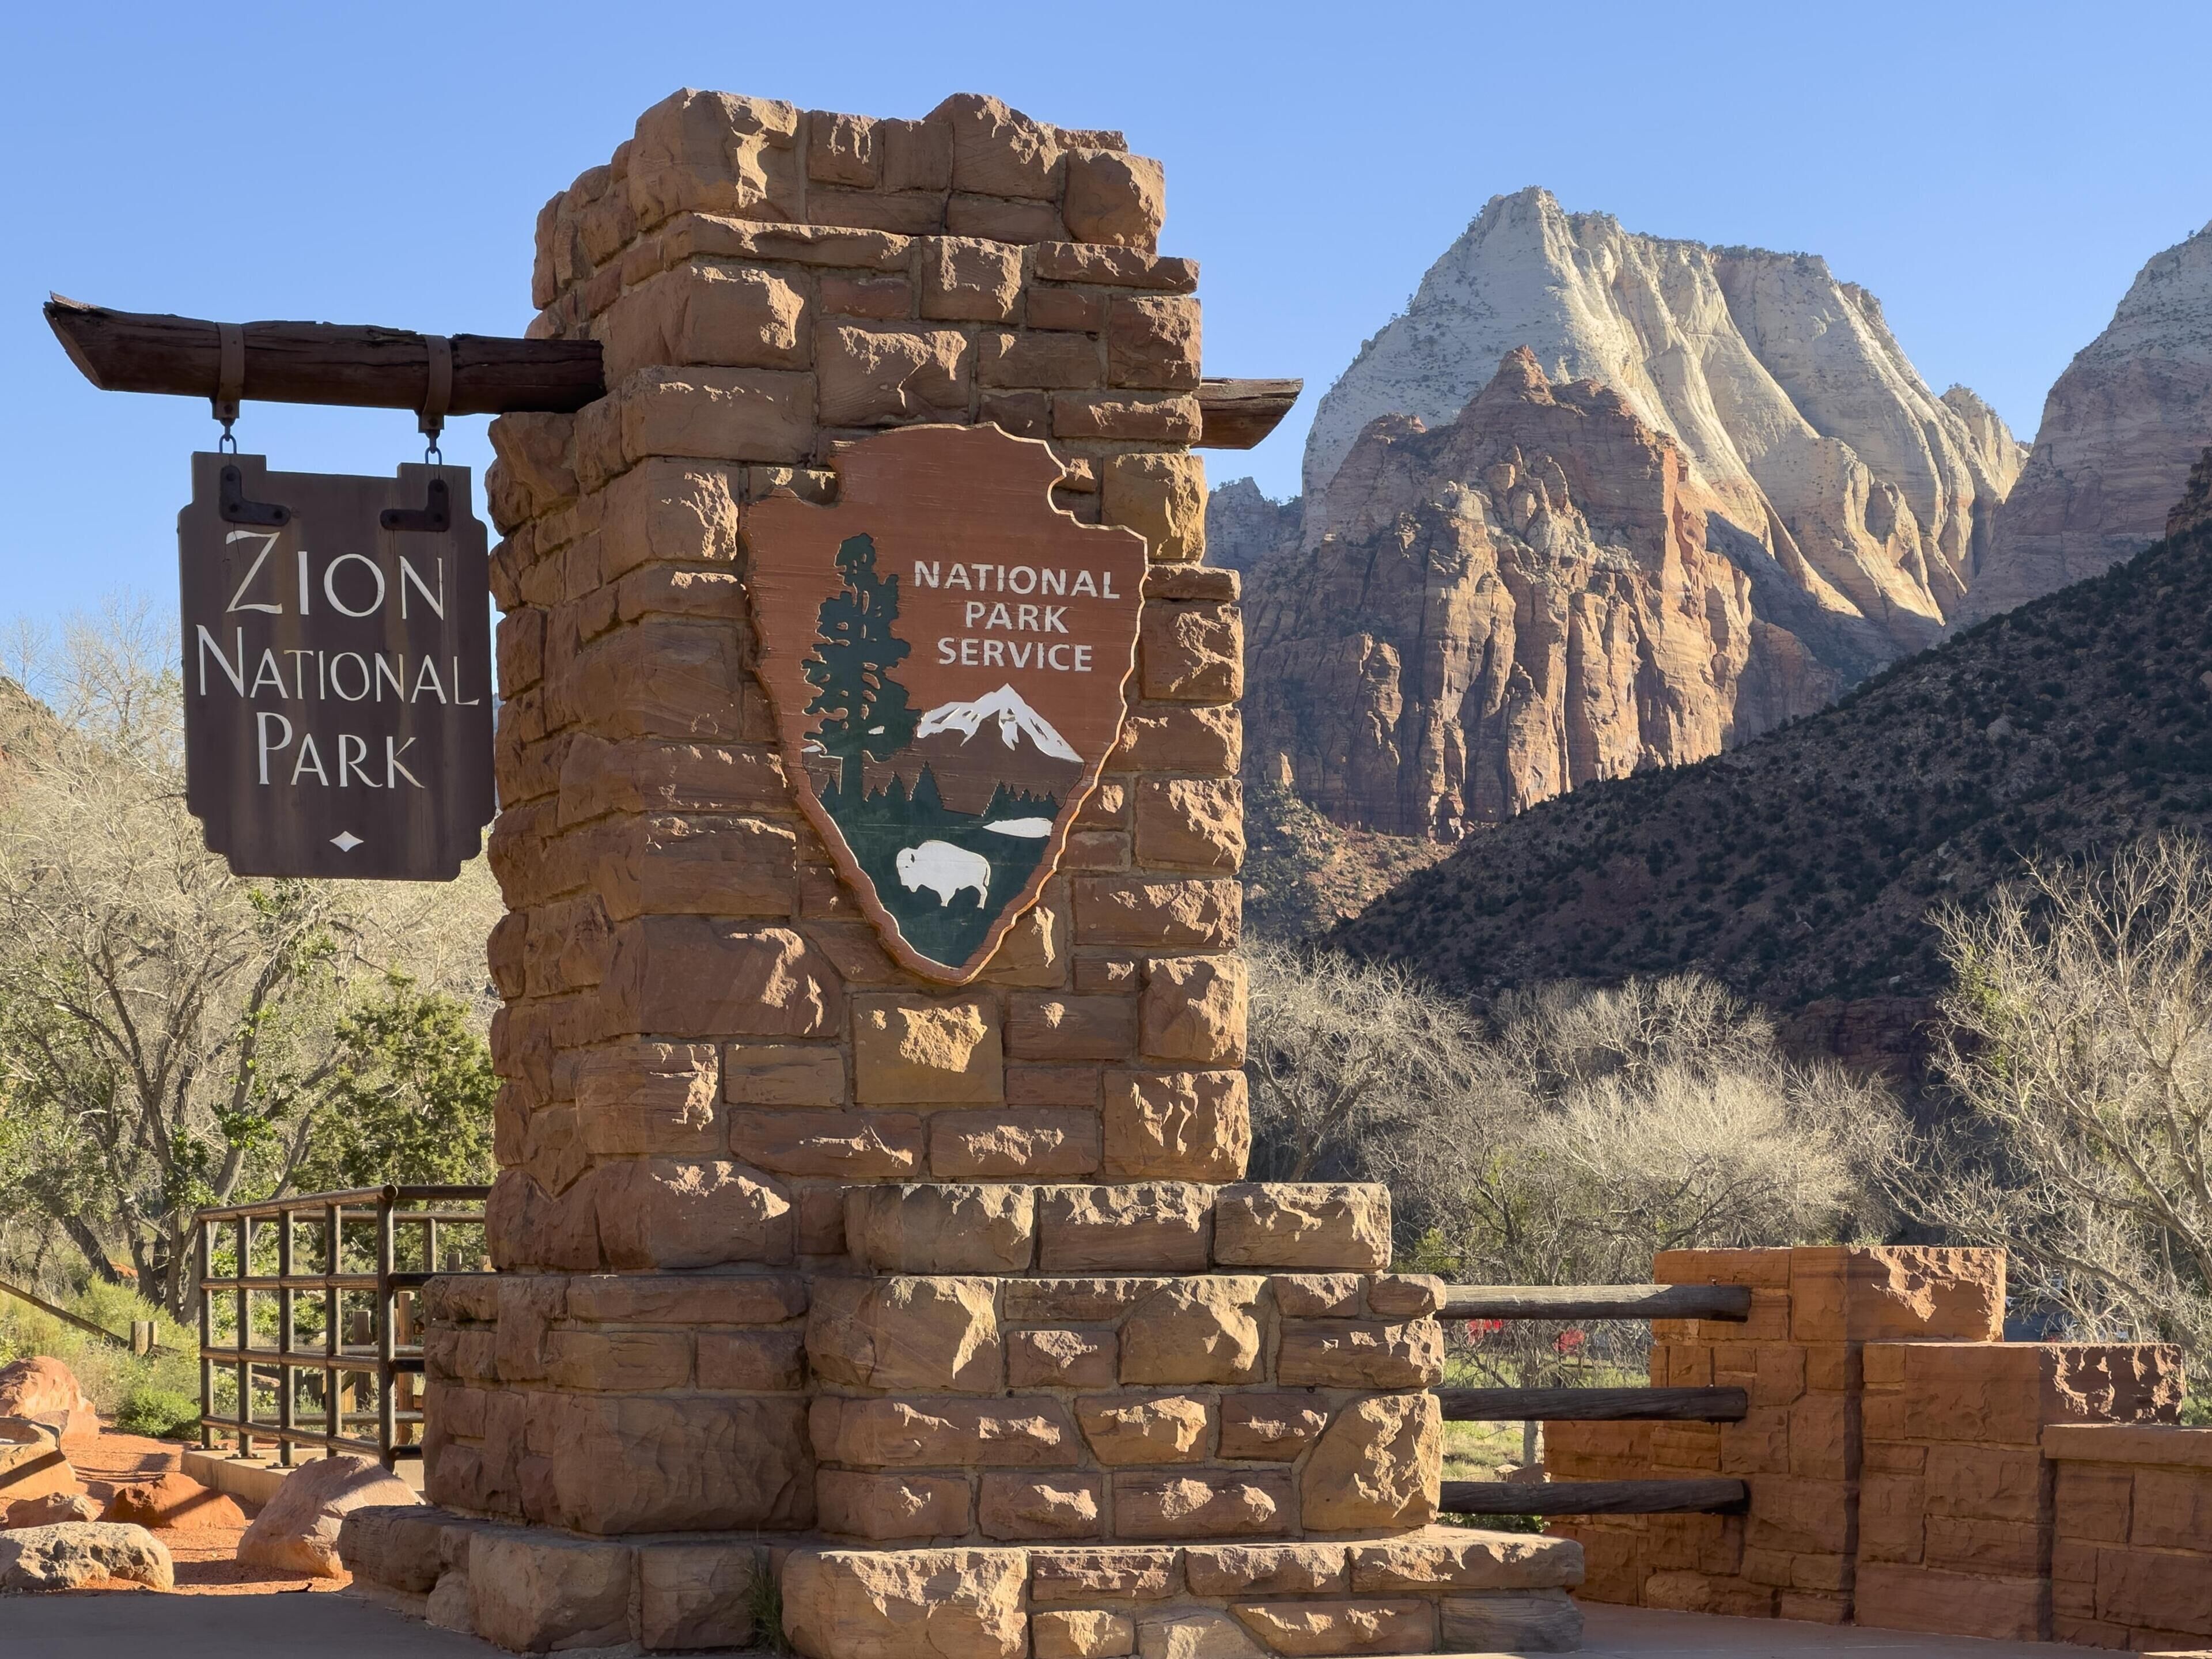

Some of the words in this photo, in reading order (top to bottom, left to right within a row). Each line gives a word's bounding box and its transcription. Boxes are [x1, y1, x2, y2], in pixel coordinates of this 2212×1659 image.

[914, 560, 1120, 600] NATIONAL
[965, 602, 1070, 634] PARK
[937, 637, 1093, 672] SERVICE
